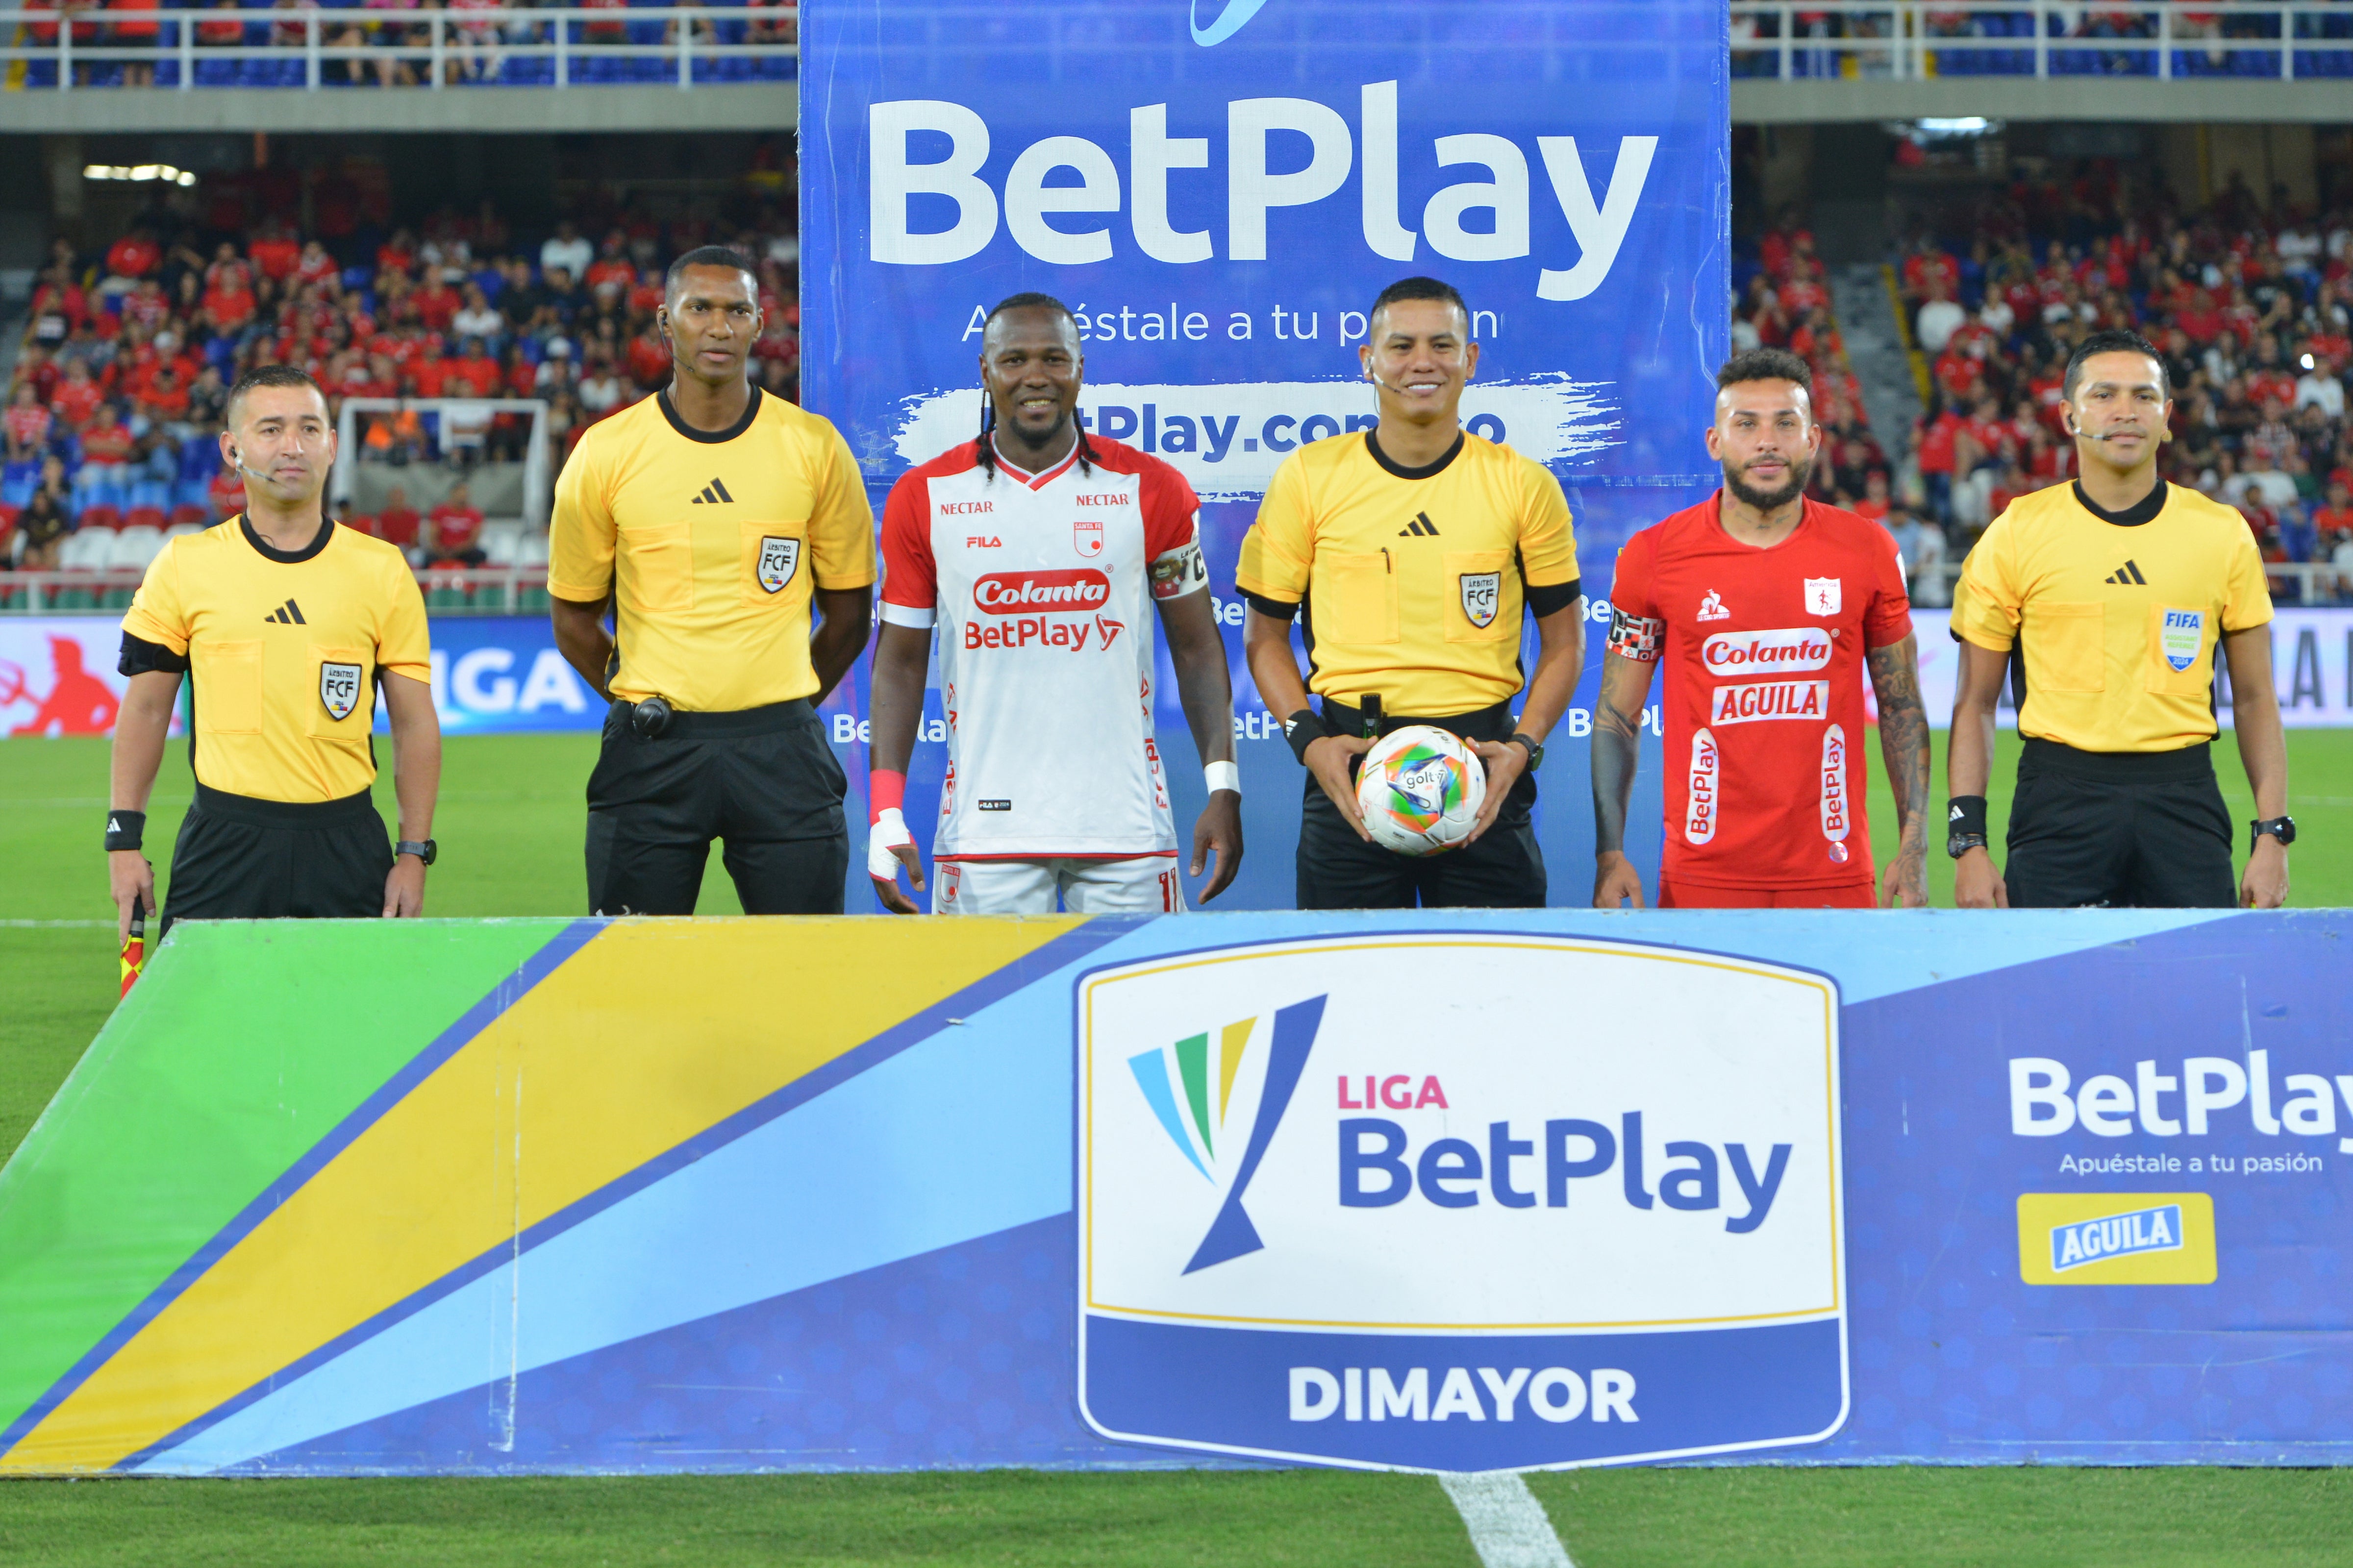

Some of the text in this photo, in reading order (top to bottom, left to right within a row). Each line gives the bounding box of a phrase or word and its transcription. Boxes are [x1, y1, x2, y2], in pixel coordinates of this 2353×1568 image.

[870, 79, 1659, 302] BetPlay
[962, 302, 1209, 342] Aéstale
[1227, 310, 1251, 341] a
[1271, 304, 1318, 341] tu
[941, 501, 994, 515] NECTAR
[1076, 494, 1128, 506] NECTAR
[966, 536, 1002, 548] FILA
[763, 553, 791, 571] FCF
[1194, 550, 1205, 581] C
[976, 580, 1106, 605] Colanta
[1468, 588, 1494, 606] FCF
[965, 615, 1090, 652] BetPlay
[2166, 612, 2200, 628] FIFA
[1706, 640, 1827, 665] Colanta
[326, 679, 353, 697] FCF
[373, 647, 586, 713] IGA
[1719, 684, 1820, 721] AGUILA
[1690, 739, 1717, 835] BetPlay
[1824, 737, 1843, 831] BetPlay
[1338, 1074, 1449, 1110] LIGA
[1338, 1110, 1793, 1234] BetPlay
[2059, 1153, 2323, 1176] Apuéstale a tu pasión
[2060, 1211, 2173, 1266] AGUILA
[1289, 1366, 1639, 1422] DIMAYOR
